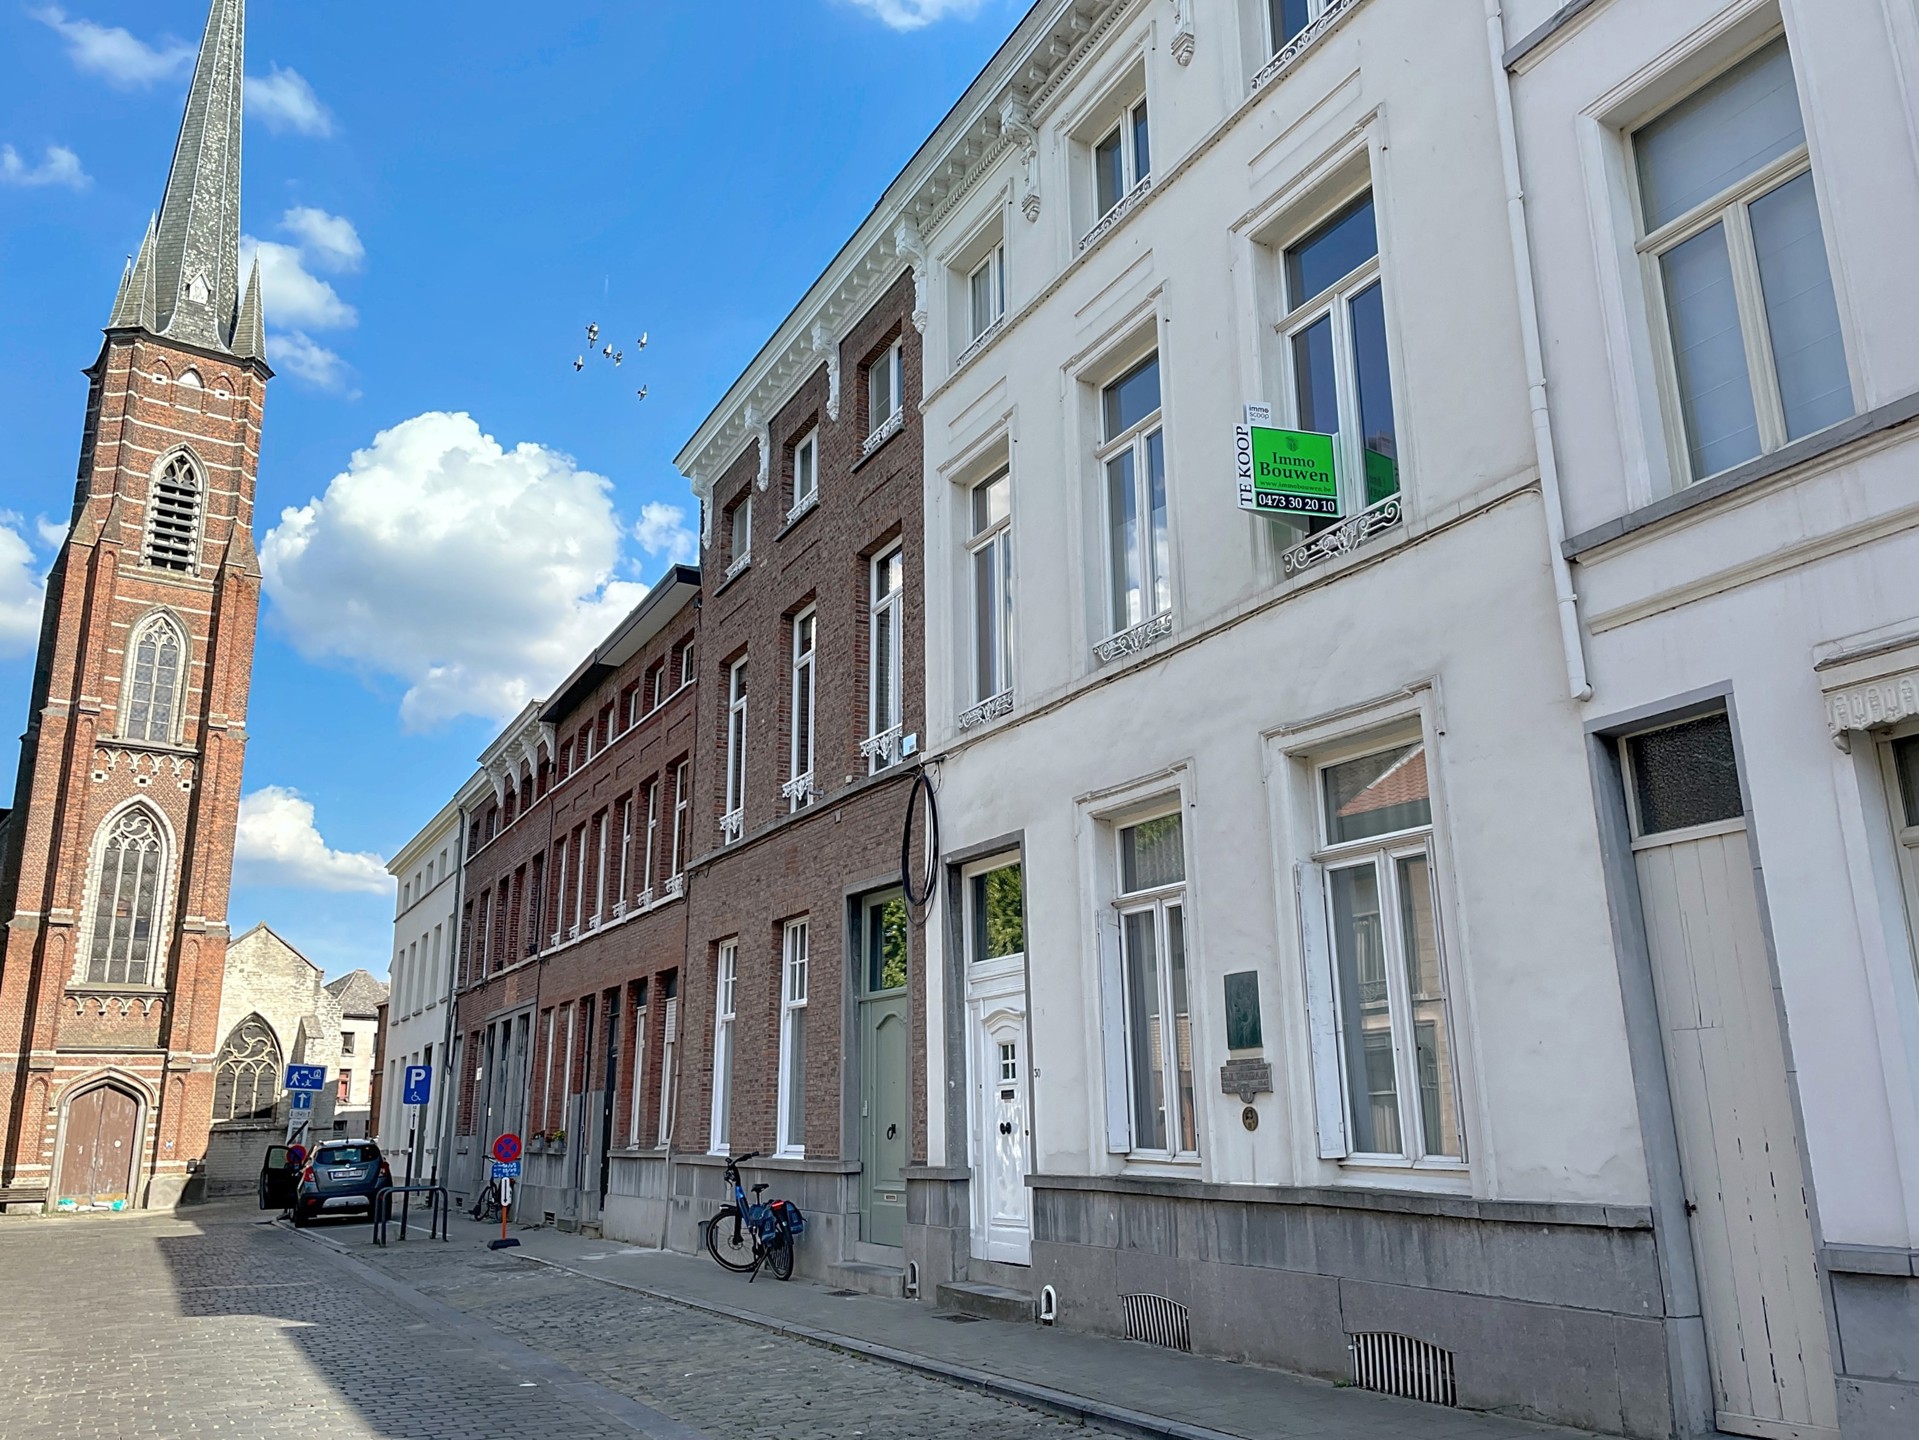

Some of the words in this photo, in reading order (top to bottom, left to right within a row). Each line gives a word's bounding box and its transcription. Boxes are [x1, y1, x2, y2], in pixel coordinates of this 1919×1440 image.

[1249, 404, 1269, 413] immo
[1249, 412, 1269, 420] scoop
[1236, 426, 1251, 479] KOOP
[1272, 452, 1315, 468] Immo
[1260, 462, 1329, 482] Bouwen
[1240, 483, 1253, 505] TE
[1258, 494, 1286, 507] 0473
[1288, 496, 1302, 509] 30
[1305, 499, 1319, 510] 20
[1321, 500, 1335, 512] 10
[410, 1068, 426, 1089] P
